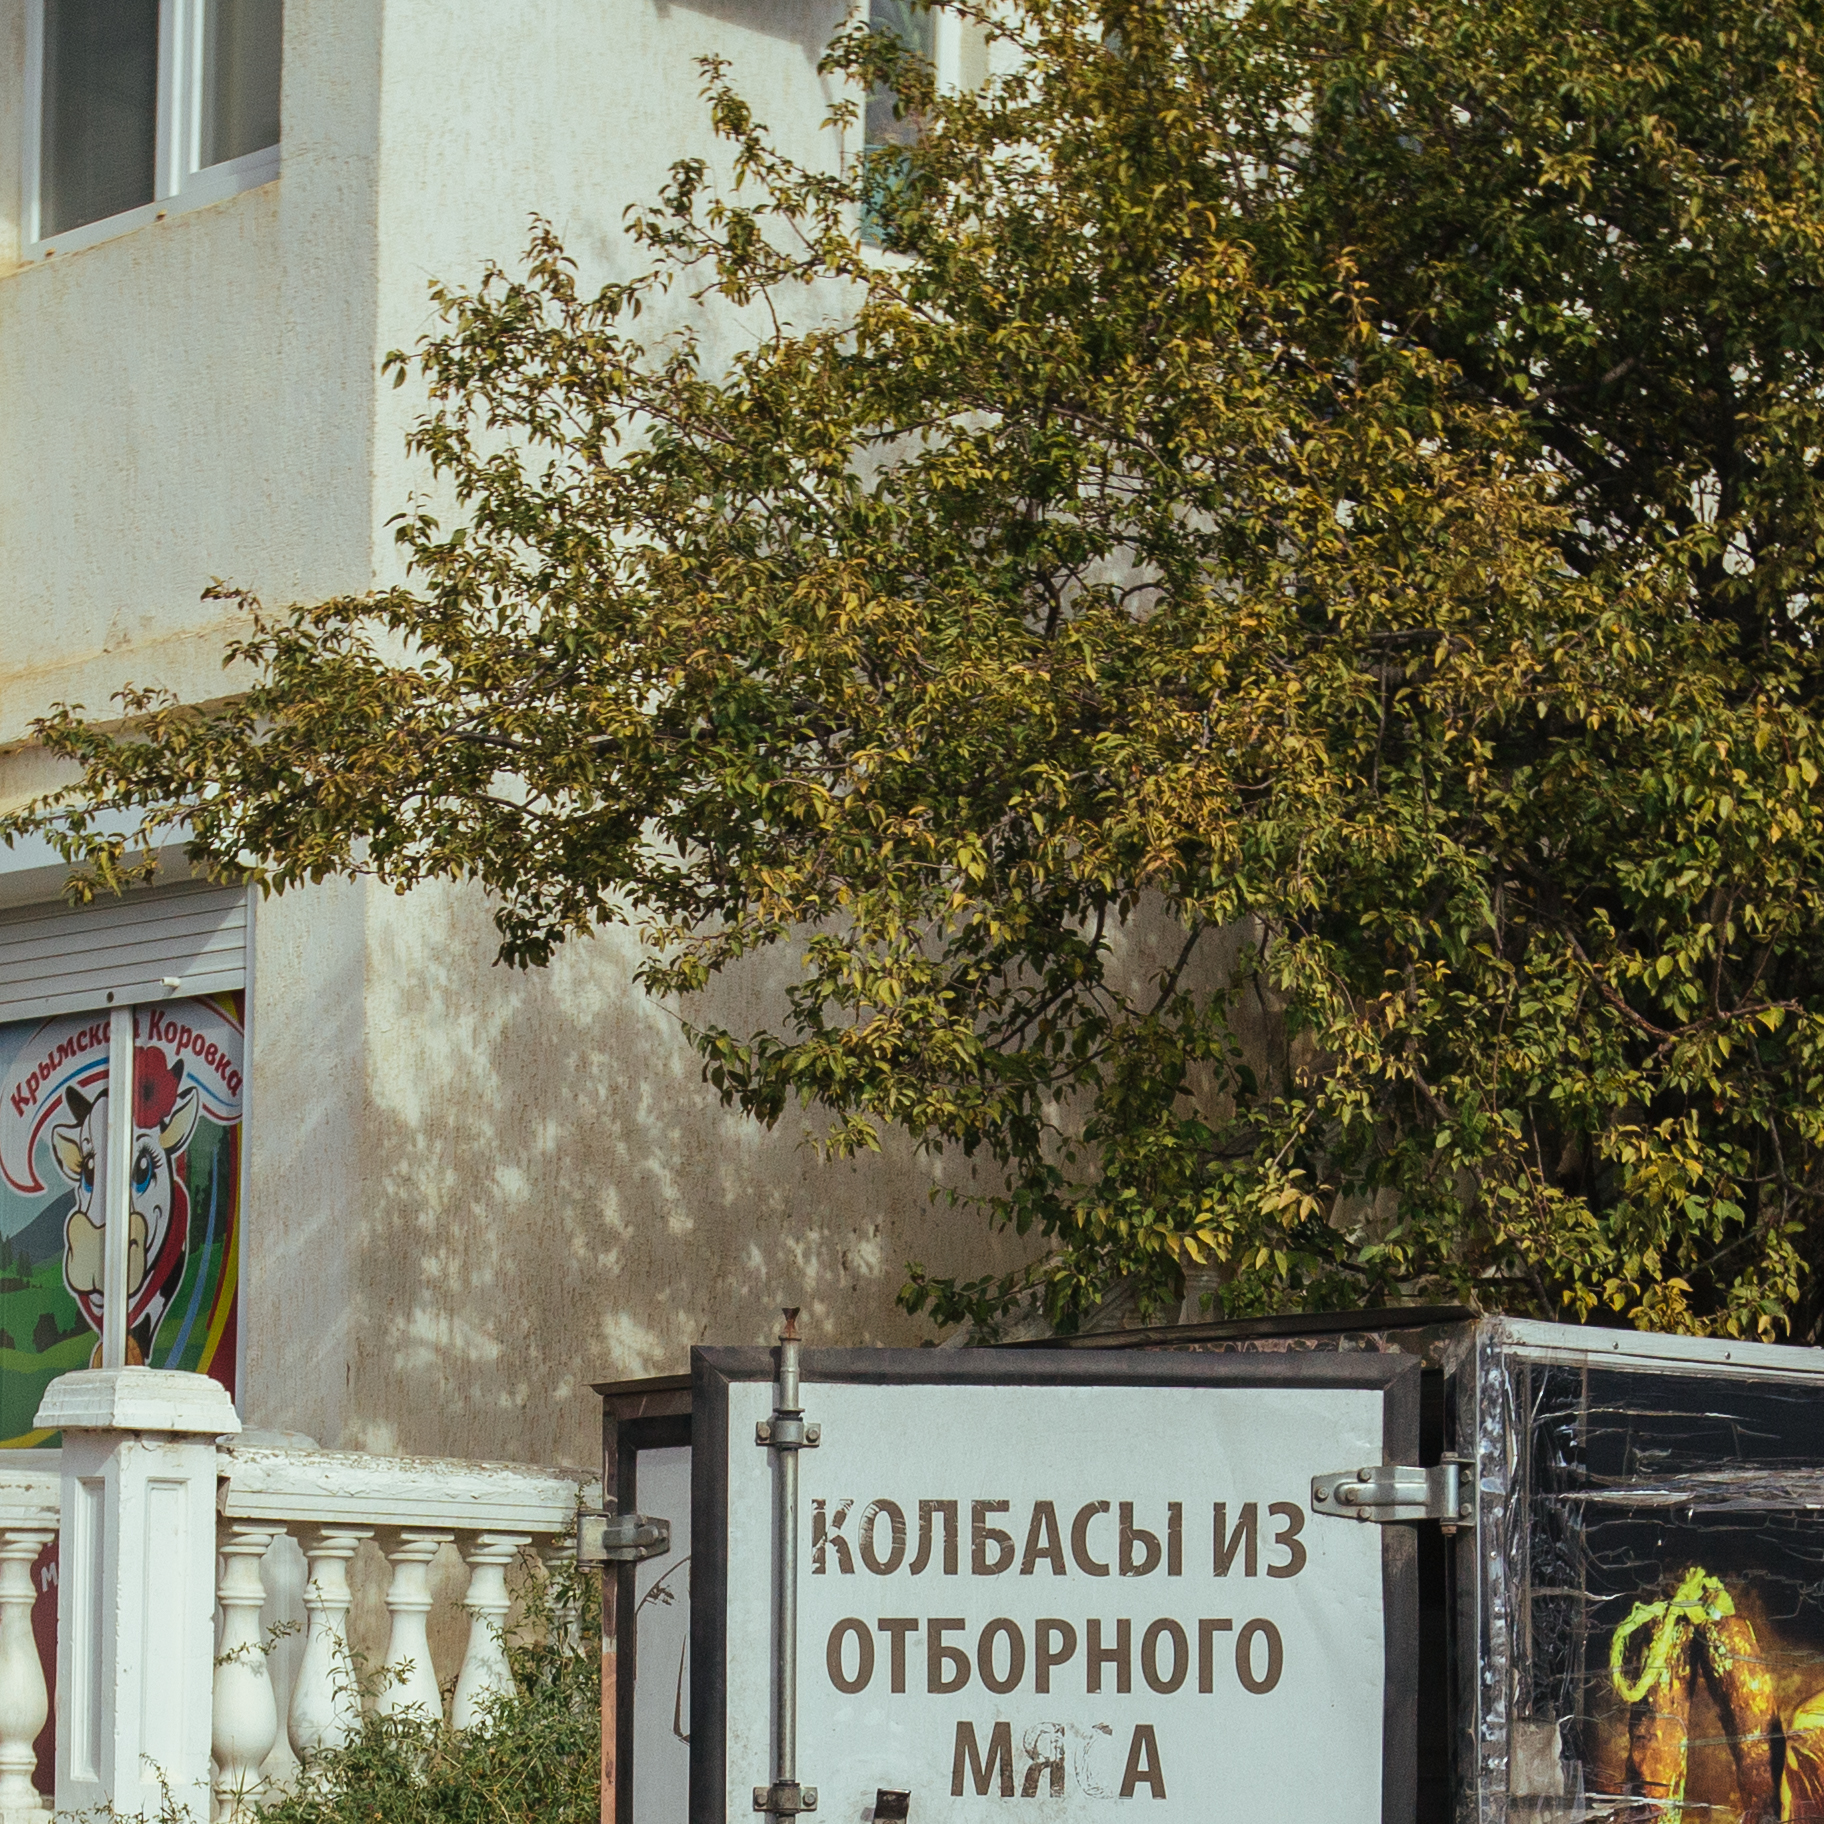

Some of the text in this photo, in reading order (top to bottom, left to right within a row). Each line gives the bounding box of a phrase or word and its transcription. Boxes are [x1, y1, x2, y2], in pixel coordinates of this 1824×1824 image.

[148, 1009, 243, 1097] Коровка
[811, 1498, 1307, 1579] КОЛБАСЫ ИЗ
[825, 1617, 1284, 1694] ОТБОРНОГО
[950, 1720, 1167, 1800] МЯА
